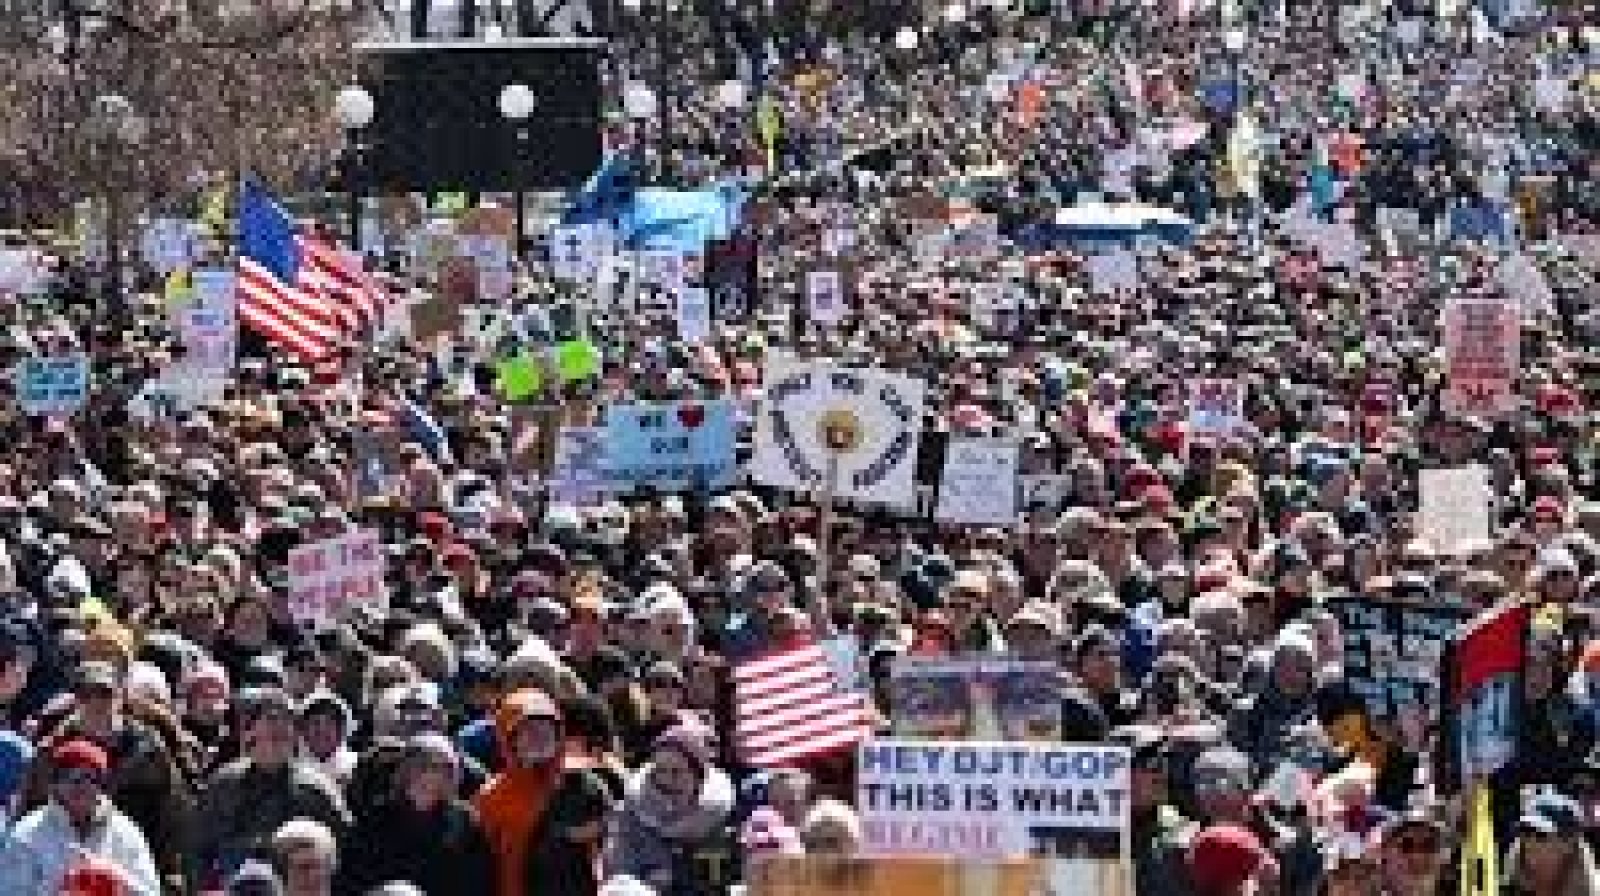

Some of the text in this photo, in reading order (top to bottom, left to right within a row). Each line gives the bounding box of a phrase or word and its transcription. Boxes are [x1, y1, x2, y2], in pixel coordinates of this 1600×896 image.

[863, 746, 945, 774] HEY
[862, 784, 1122, 817] THIS IS WHAT
